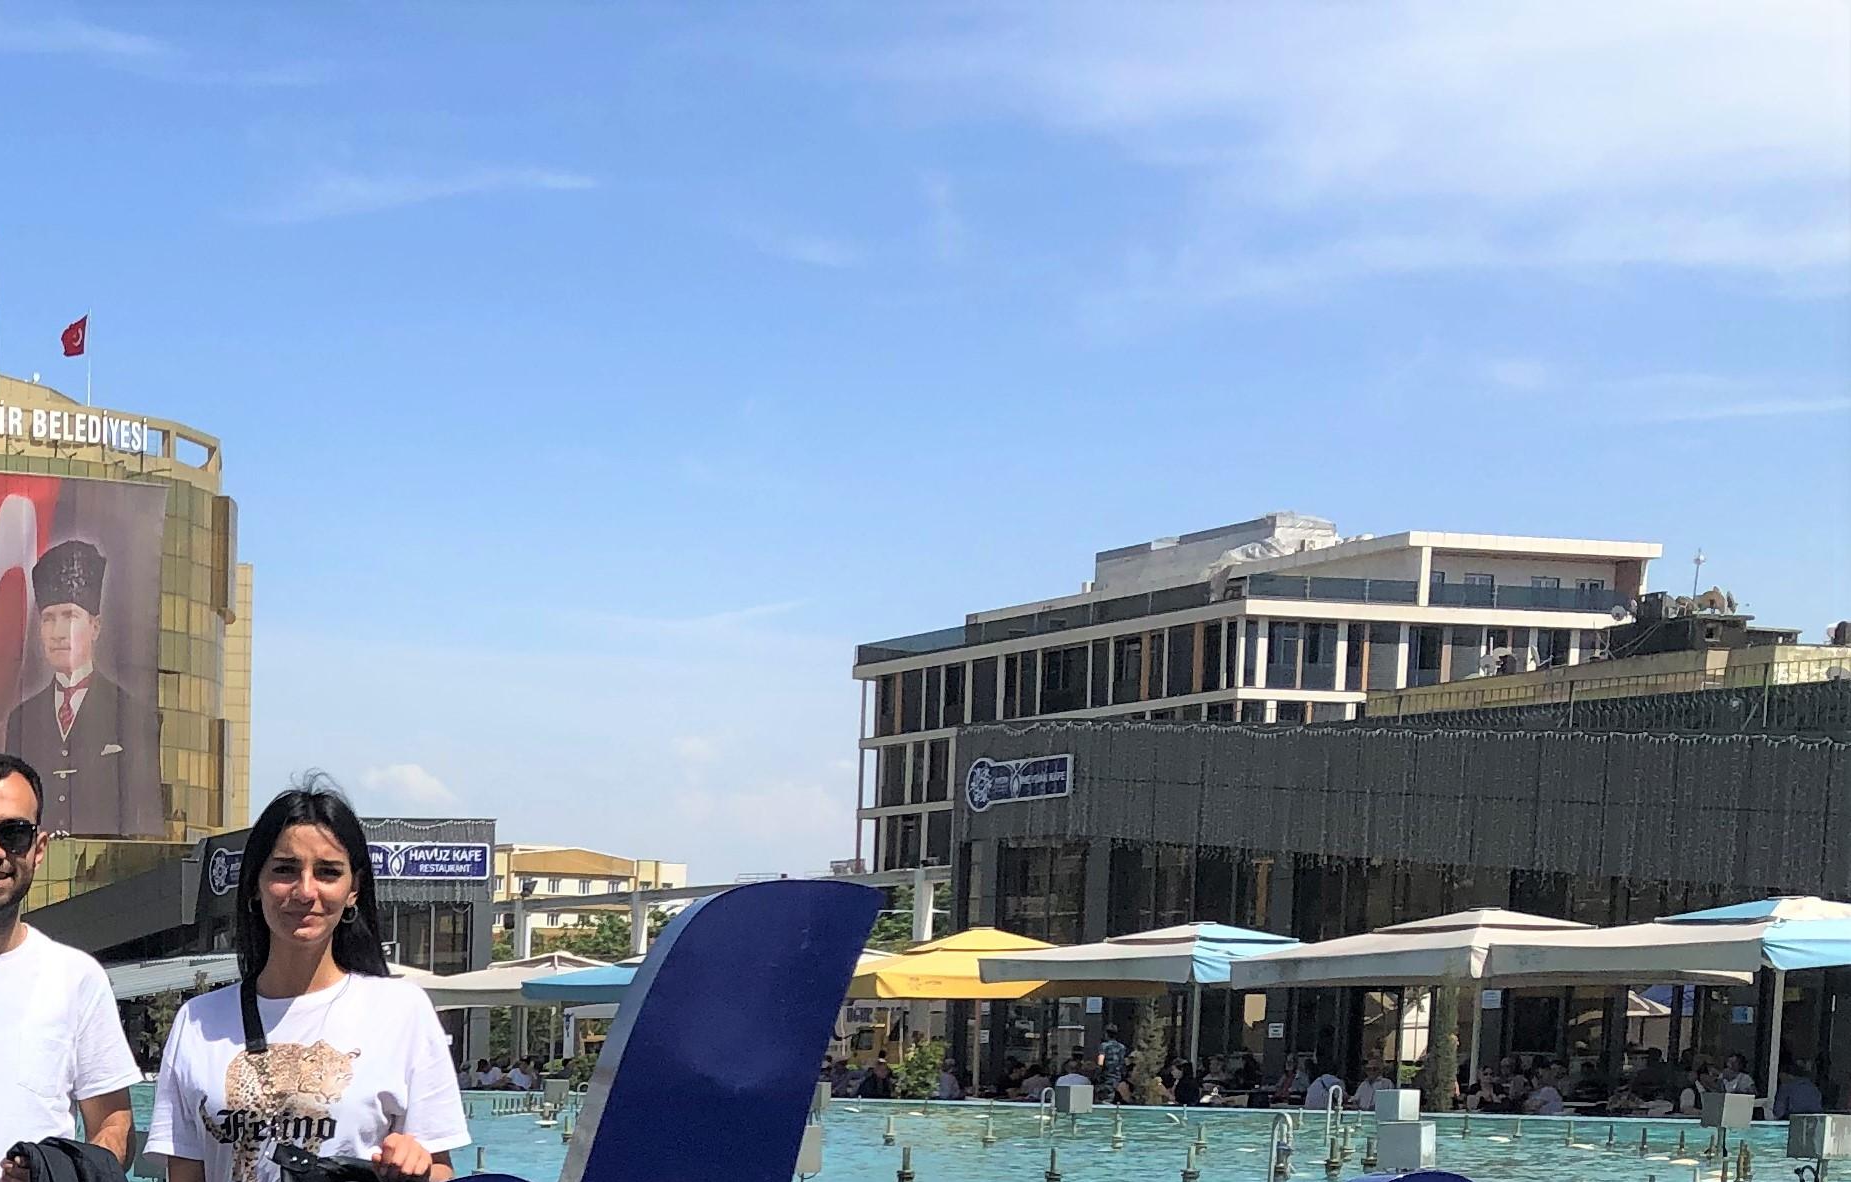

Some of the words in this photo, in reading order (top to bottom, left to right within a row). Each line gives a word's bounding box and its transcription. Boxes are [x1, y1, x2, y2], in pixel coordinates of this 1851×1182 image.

[32, 409, 149, 452] BELEDİYESİ
[409, 848, 450, 862] HAVUZ
[452, 849, 483, 861] KAFE
[419, 863, 472, 873] RESTAURANT
